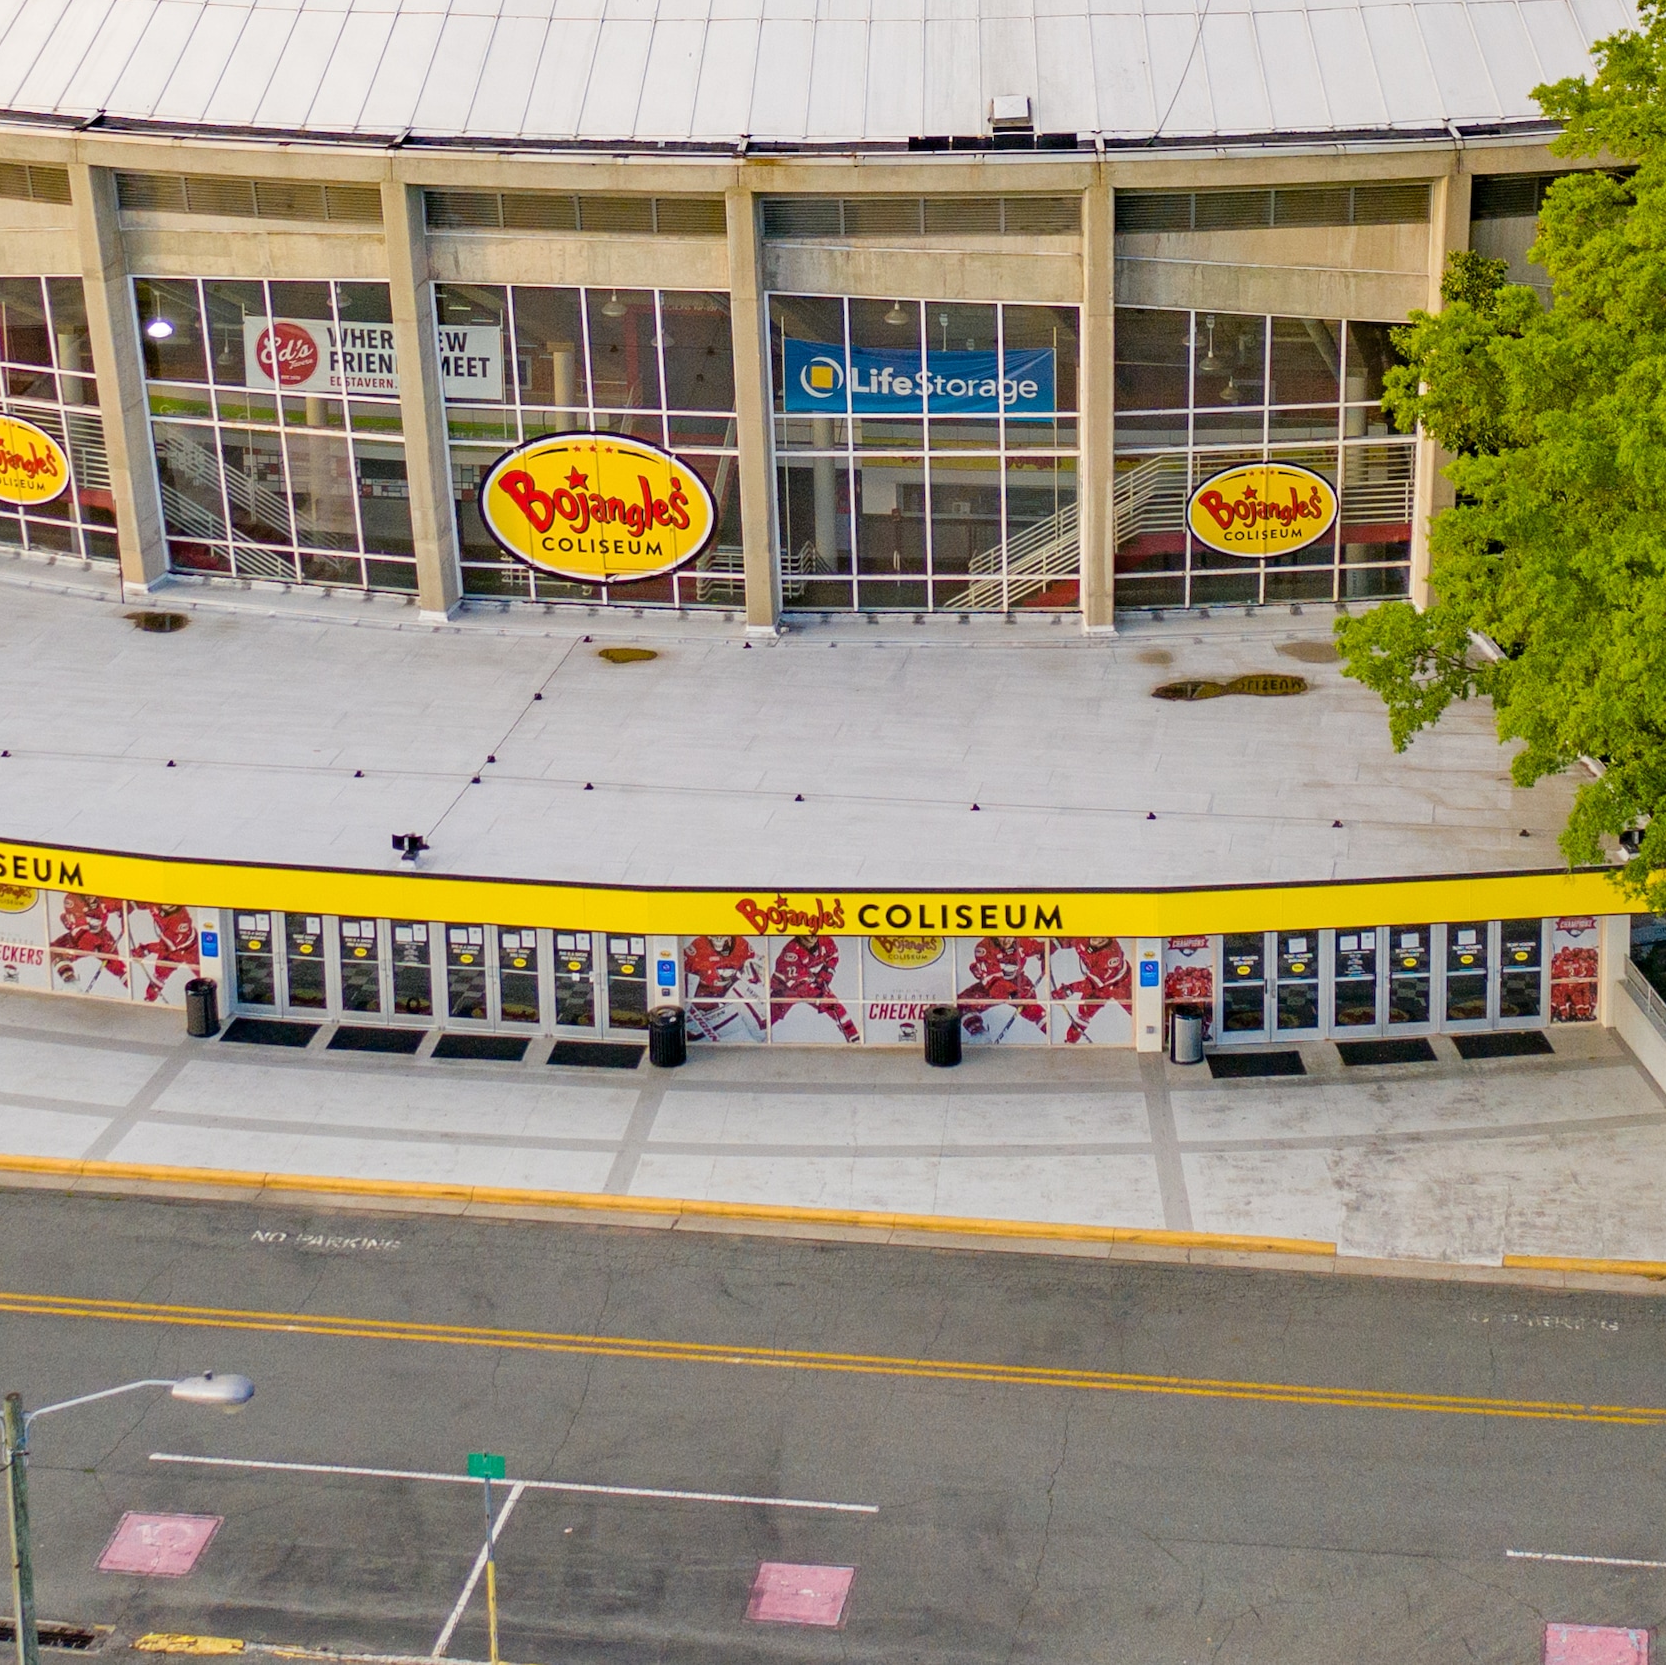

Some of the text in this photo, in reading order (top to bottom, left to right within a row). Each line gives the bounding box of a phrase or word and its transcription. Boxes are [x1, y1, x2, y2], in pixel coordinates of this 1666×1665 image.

[327, 327, 394, 350] WHER
[261, 337, 314, 364] Ed's
[330, 351, 398, 374] FRIEN
[1223, 529, 1303, 541] COLISEUM
[541, 537, 664, 556] COLISEUM
[857, 904, 1063, 930] COLISEUM
[887, 953, 929, 961] COLISEUM
[868, 1003, 936, 1021] CHECKE
[250, 1230, 287, 1243] NO
